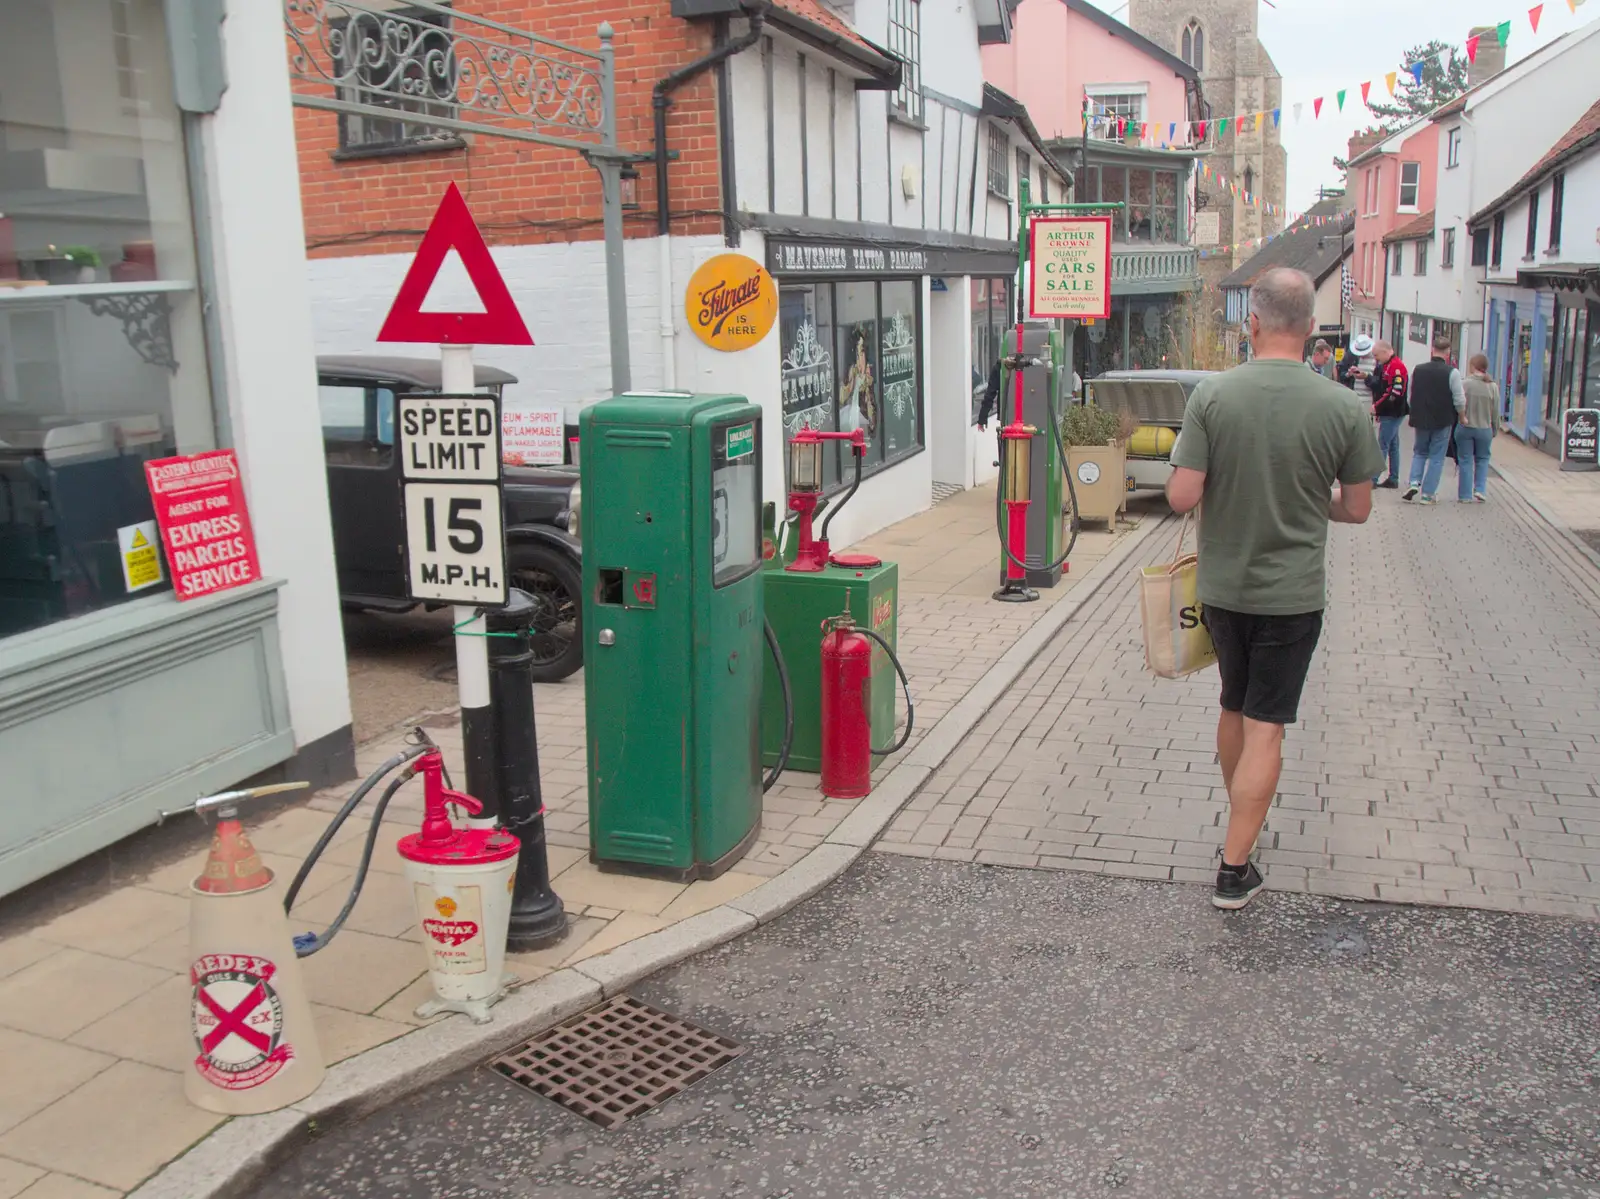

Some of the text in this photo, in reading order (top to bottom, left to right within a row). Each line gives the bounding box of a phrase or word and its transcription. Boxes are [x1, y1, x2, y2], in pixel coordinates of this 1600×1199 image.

[1047, 232, 1095, 240] ARTHUR
[853, 249, 885, 269] TATTOO
[1053, 250, 1088, 258] QUALITY
[1045, 262, 1096, 273] CARS
[1046, 280, 1094, 291] SALE
[736, 314, 747, 324] IS
[728, 325, 757, 335] HERE
[782, 370, 833, 405] TATTOOS
[403, 407, 492, 437] SPEED
[502, 412, 522, 423] EUM
[529, 412, 558, 423] SPIRIT
[502, 426, 562, 437] NFLAMMABLE
[1568, 438, 1596, 448] OPEN
[411, 442, 486, 470] LIMIT
[168, 495, 230, 518] AGENT FOR
[167, 513, 242, 548] EXPRESS
[424, 497, 484, 554] 15
[174, 536, 247, 572] PARCELS
[180, 560, 251, 595] SERVICE
[421, 563, 499, 589] M.P.H.
[192, 954, 269, 979] REDEX
[207, 972, 246, 983] OILS &
